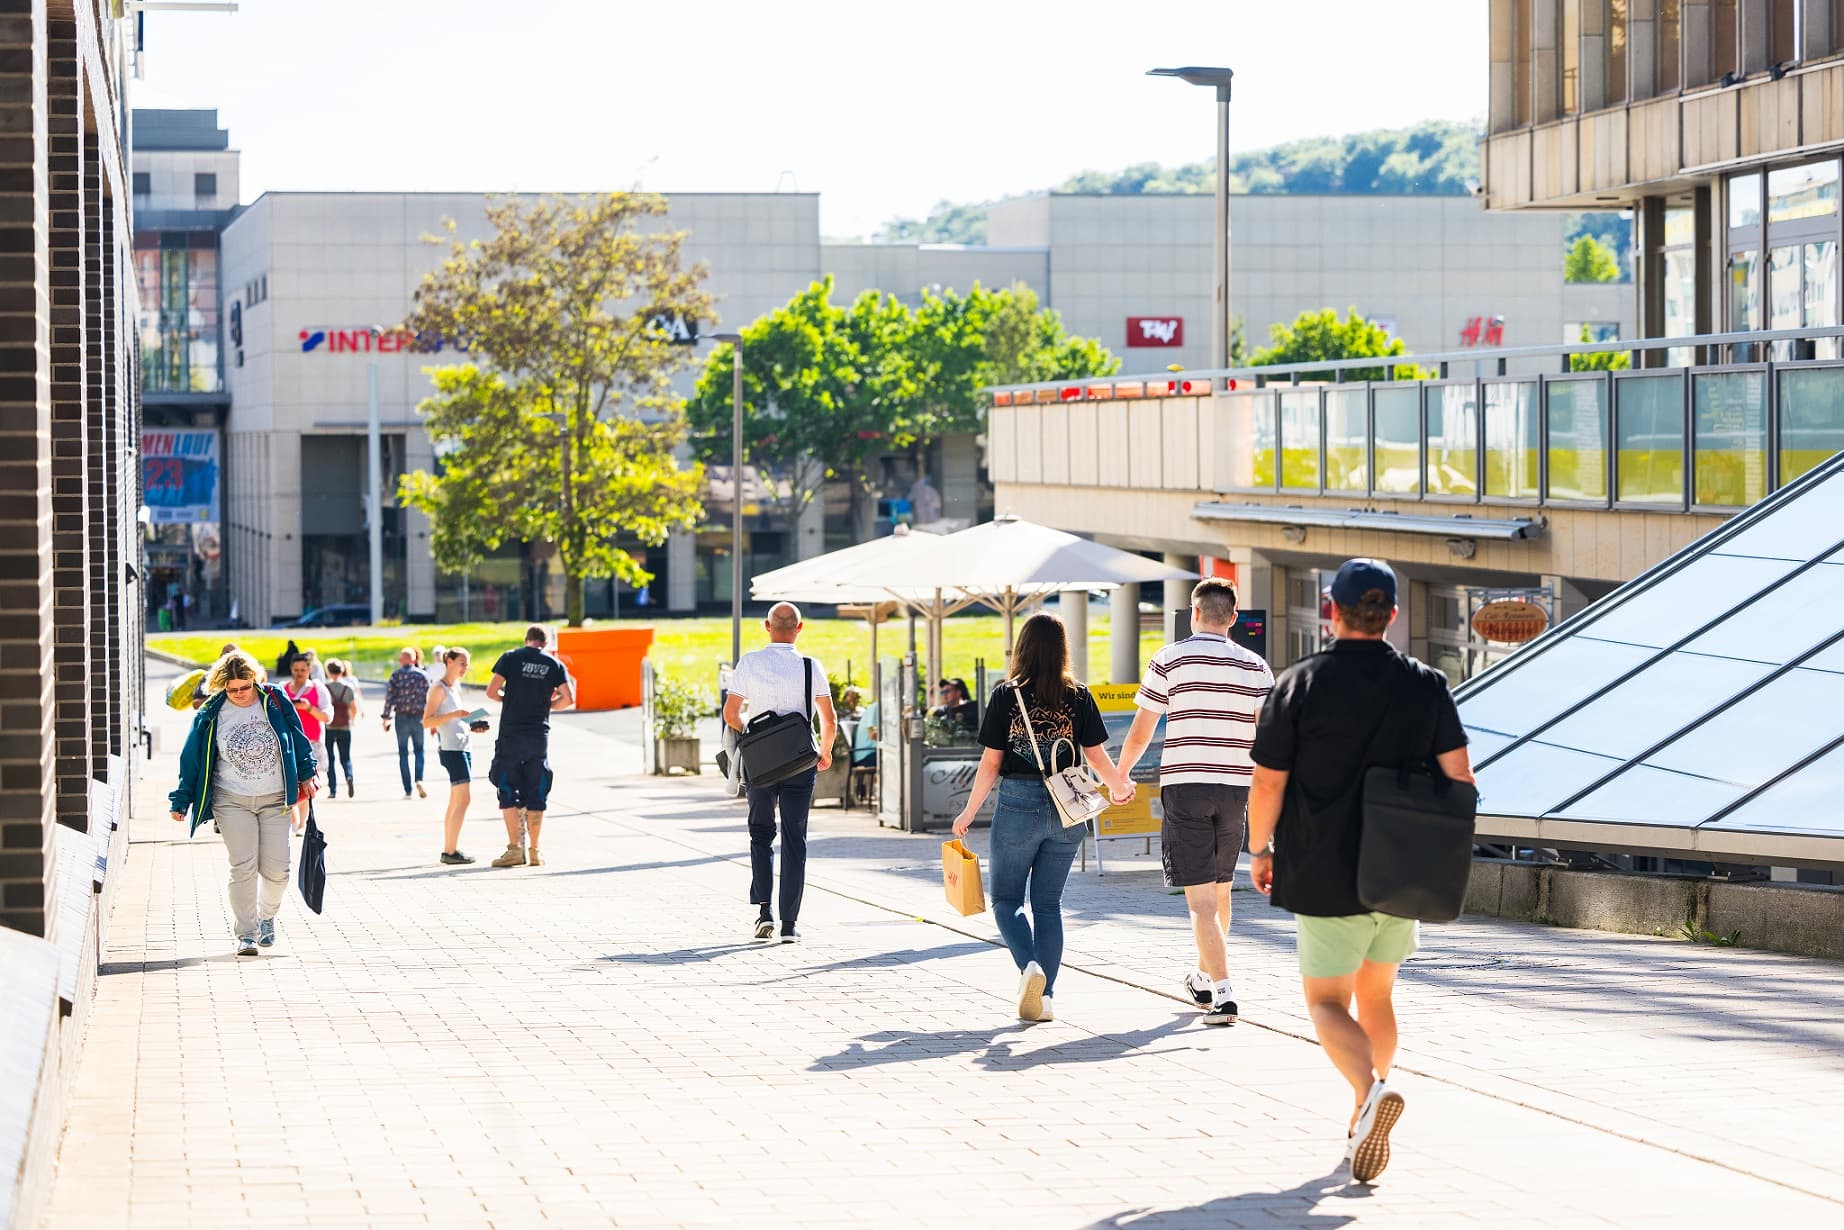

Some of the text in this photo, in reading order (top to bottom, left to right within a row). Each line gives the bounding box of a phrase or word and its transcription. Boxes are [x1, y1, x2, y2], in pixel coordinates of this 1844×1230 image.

[1460, 316, 1504, 347] HM
[145, 459, 183, 490] 23
[1099, 691, 1115, 700] Wir
